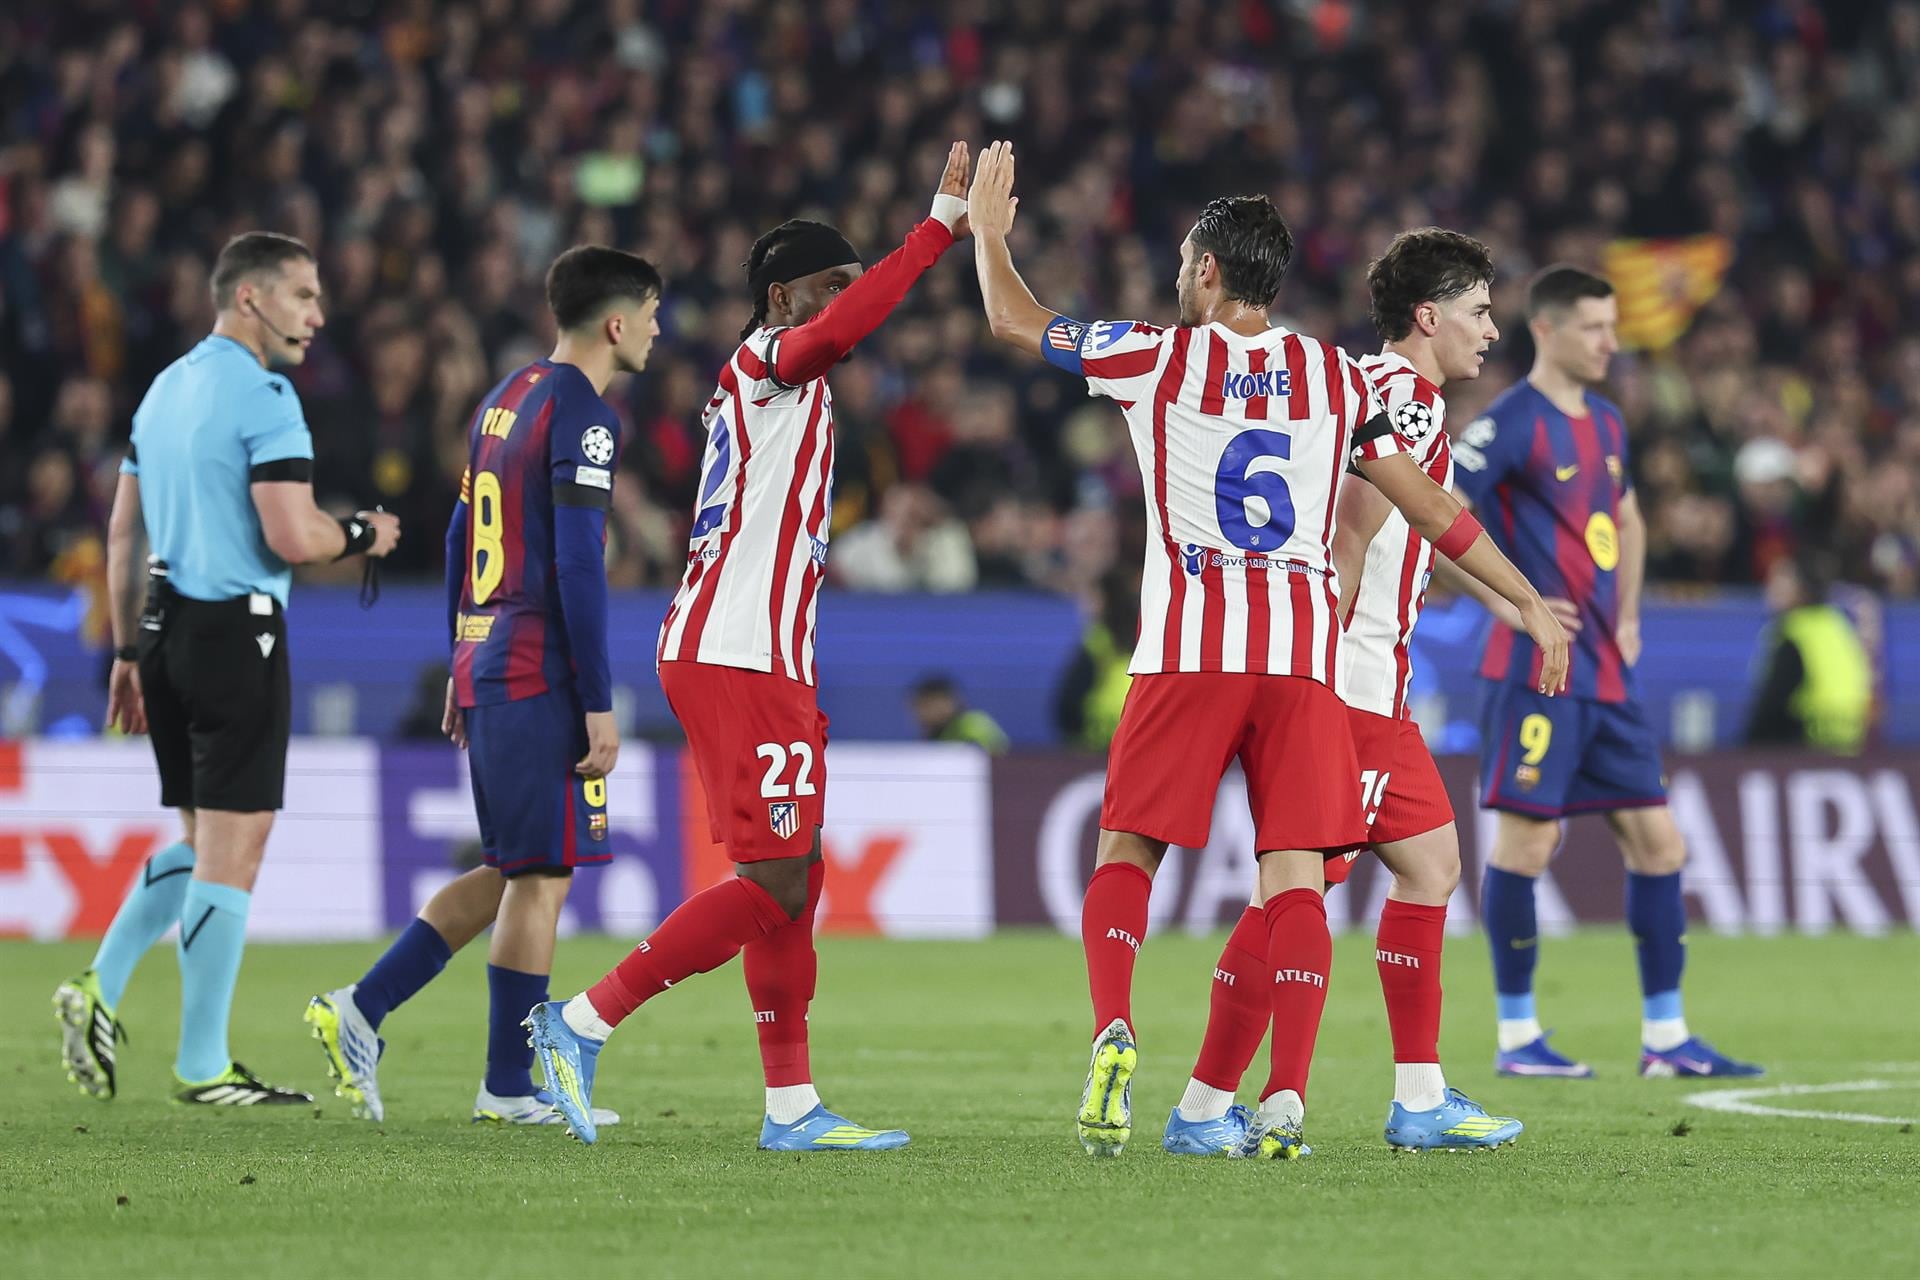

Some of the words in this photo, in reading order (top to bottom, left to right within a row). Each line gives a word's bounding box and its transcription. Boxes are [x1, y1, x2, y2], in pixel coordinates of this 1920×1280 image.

[1223, 369, 1293, 399] KOKE
[1215, 428, 1296, 553] 6
[470, 470, 505, 606] 8
[1211, 553, 1247, 567] Save
[1251, 555, 1273, 569] the
[1519, 713, 1552, 766] 9
[756, 741, 817, 798] 22
[1360, 769, 1391, 826] 19
[1275, 968, 1325, 989] ATLETI
[1376, 949, 1420, 969] ATLETI
